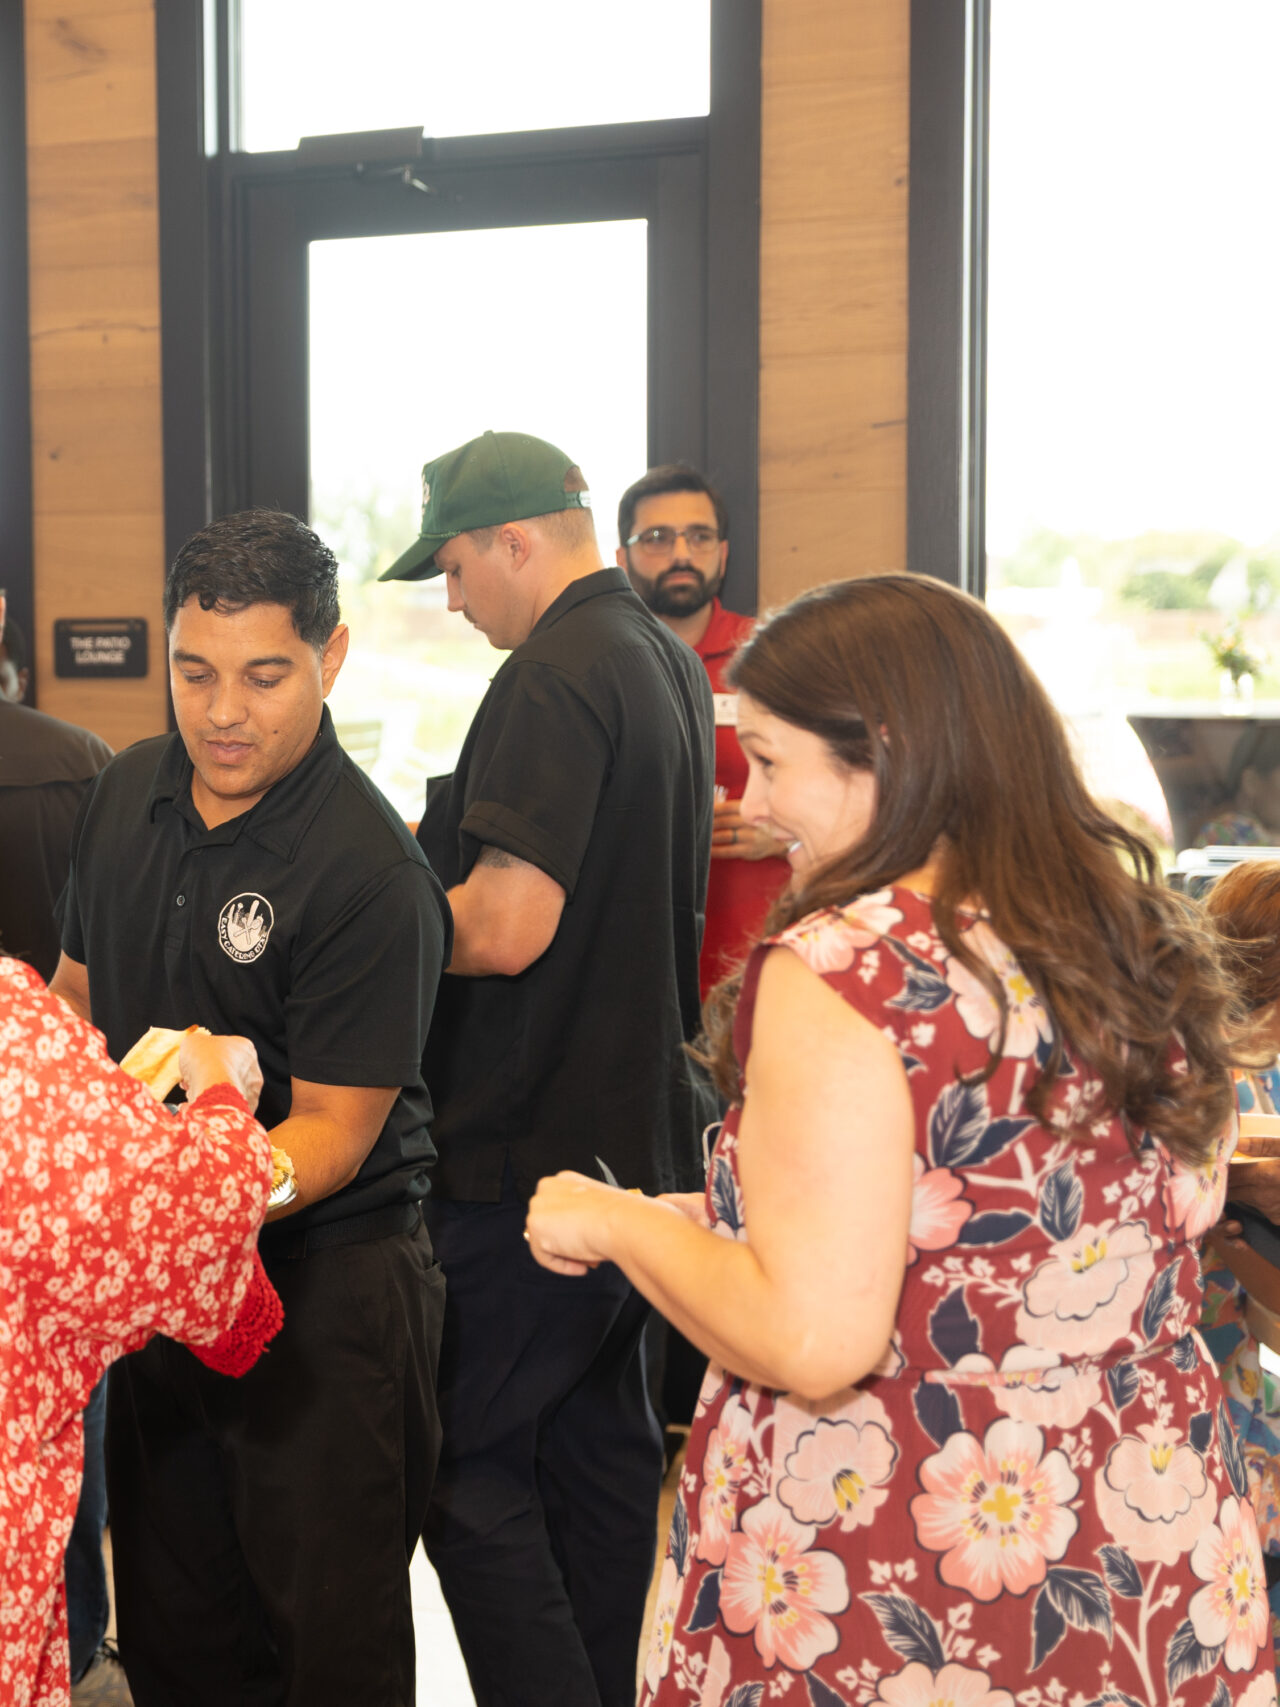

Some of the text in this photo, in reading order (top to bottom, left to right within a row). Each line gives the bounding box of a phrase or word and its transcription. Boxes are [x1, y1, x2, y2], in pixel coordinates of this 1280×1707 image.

[70, 636, 131, 650] THE PATIO
[74, 650, 125, 664] LOUNGE
